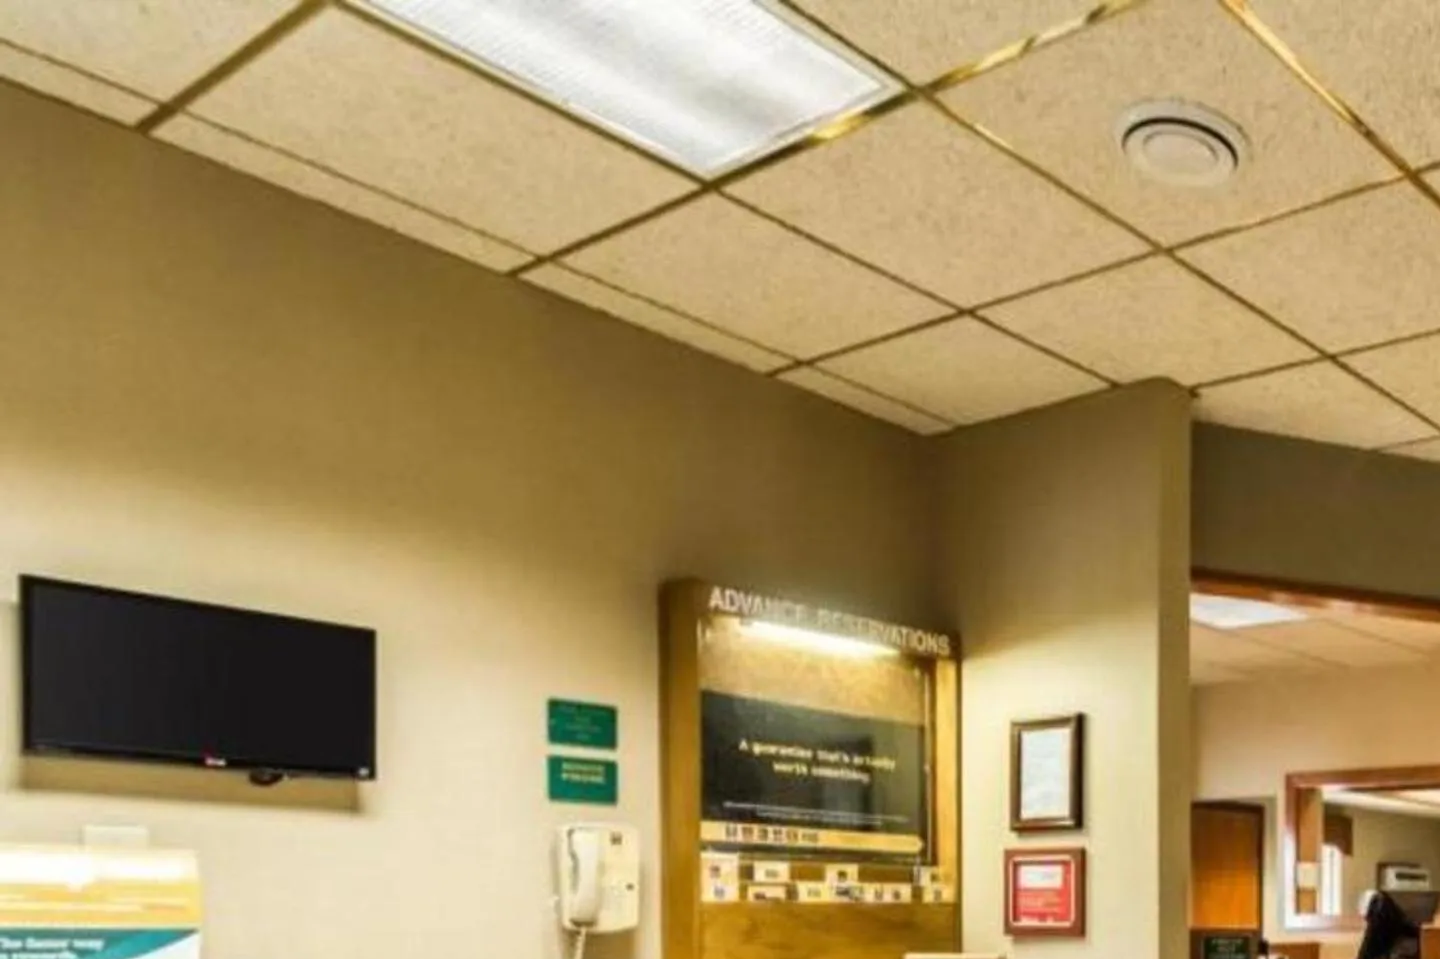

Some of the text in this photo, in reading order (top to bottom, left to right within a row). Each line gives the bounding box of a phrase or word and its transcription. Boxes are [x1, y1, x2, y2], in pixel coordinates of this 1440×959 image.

[708, 585, 952, 656] ADVANCE RESERVATIONS
[738, 738, 749, 751] A
